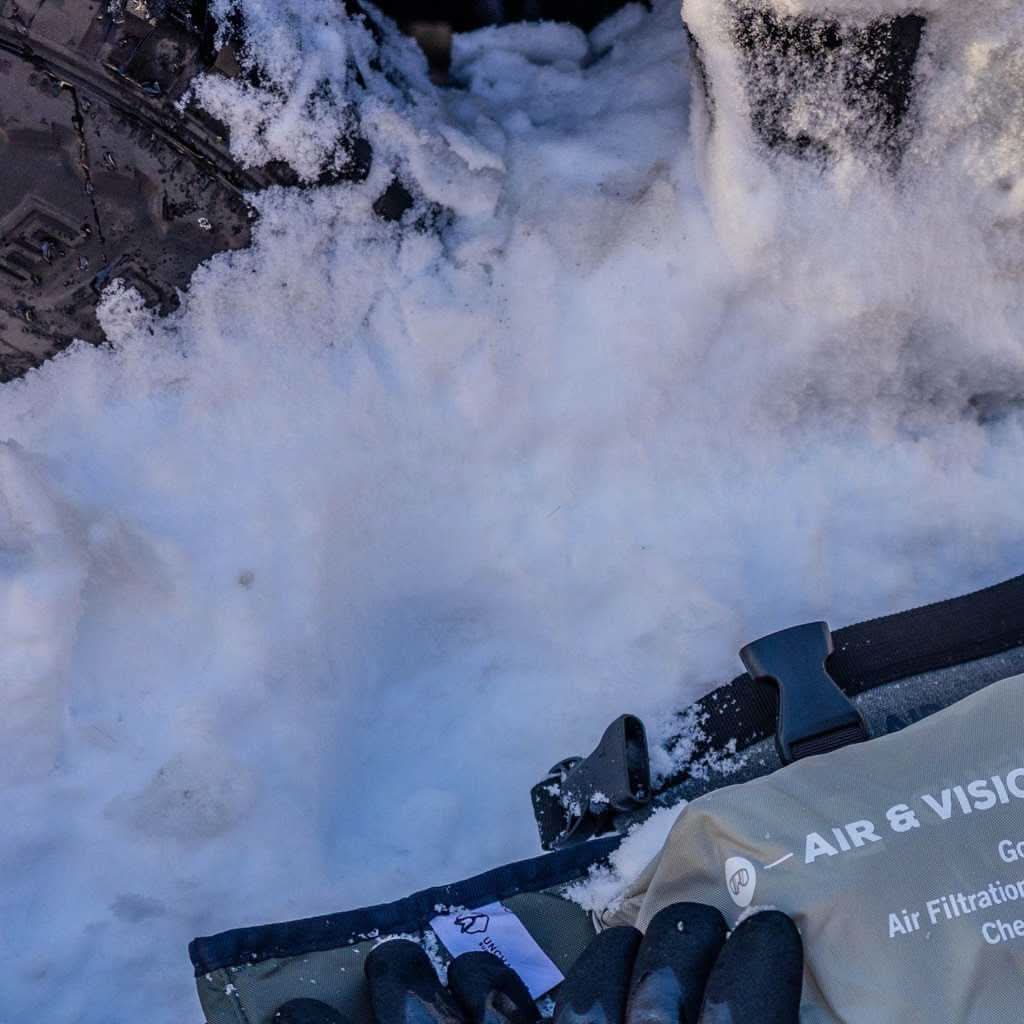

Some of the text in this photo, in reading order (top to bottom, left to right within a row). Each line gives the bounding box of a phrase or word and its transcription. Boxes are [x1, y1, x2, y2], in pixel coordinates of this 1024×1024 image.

[804, 819, 883, 864] AIR
[885, 803, 921, 833] &
[888, 909, 920, 938] Air
